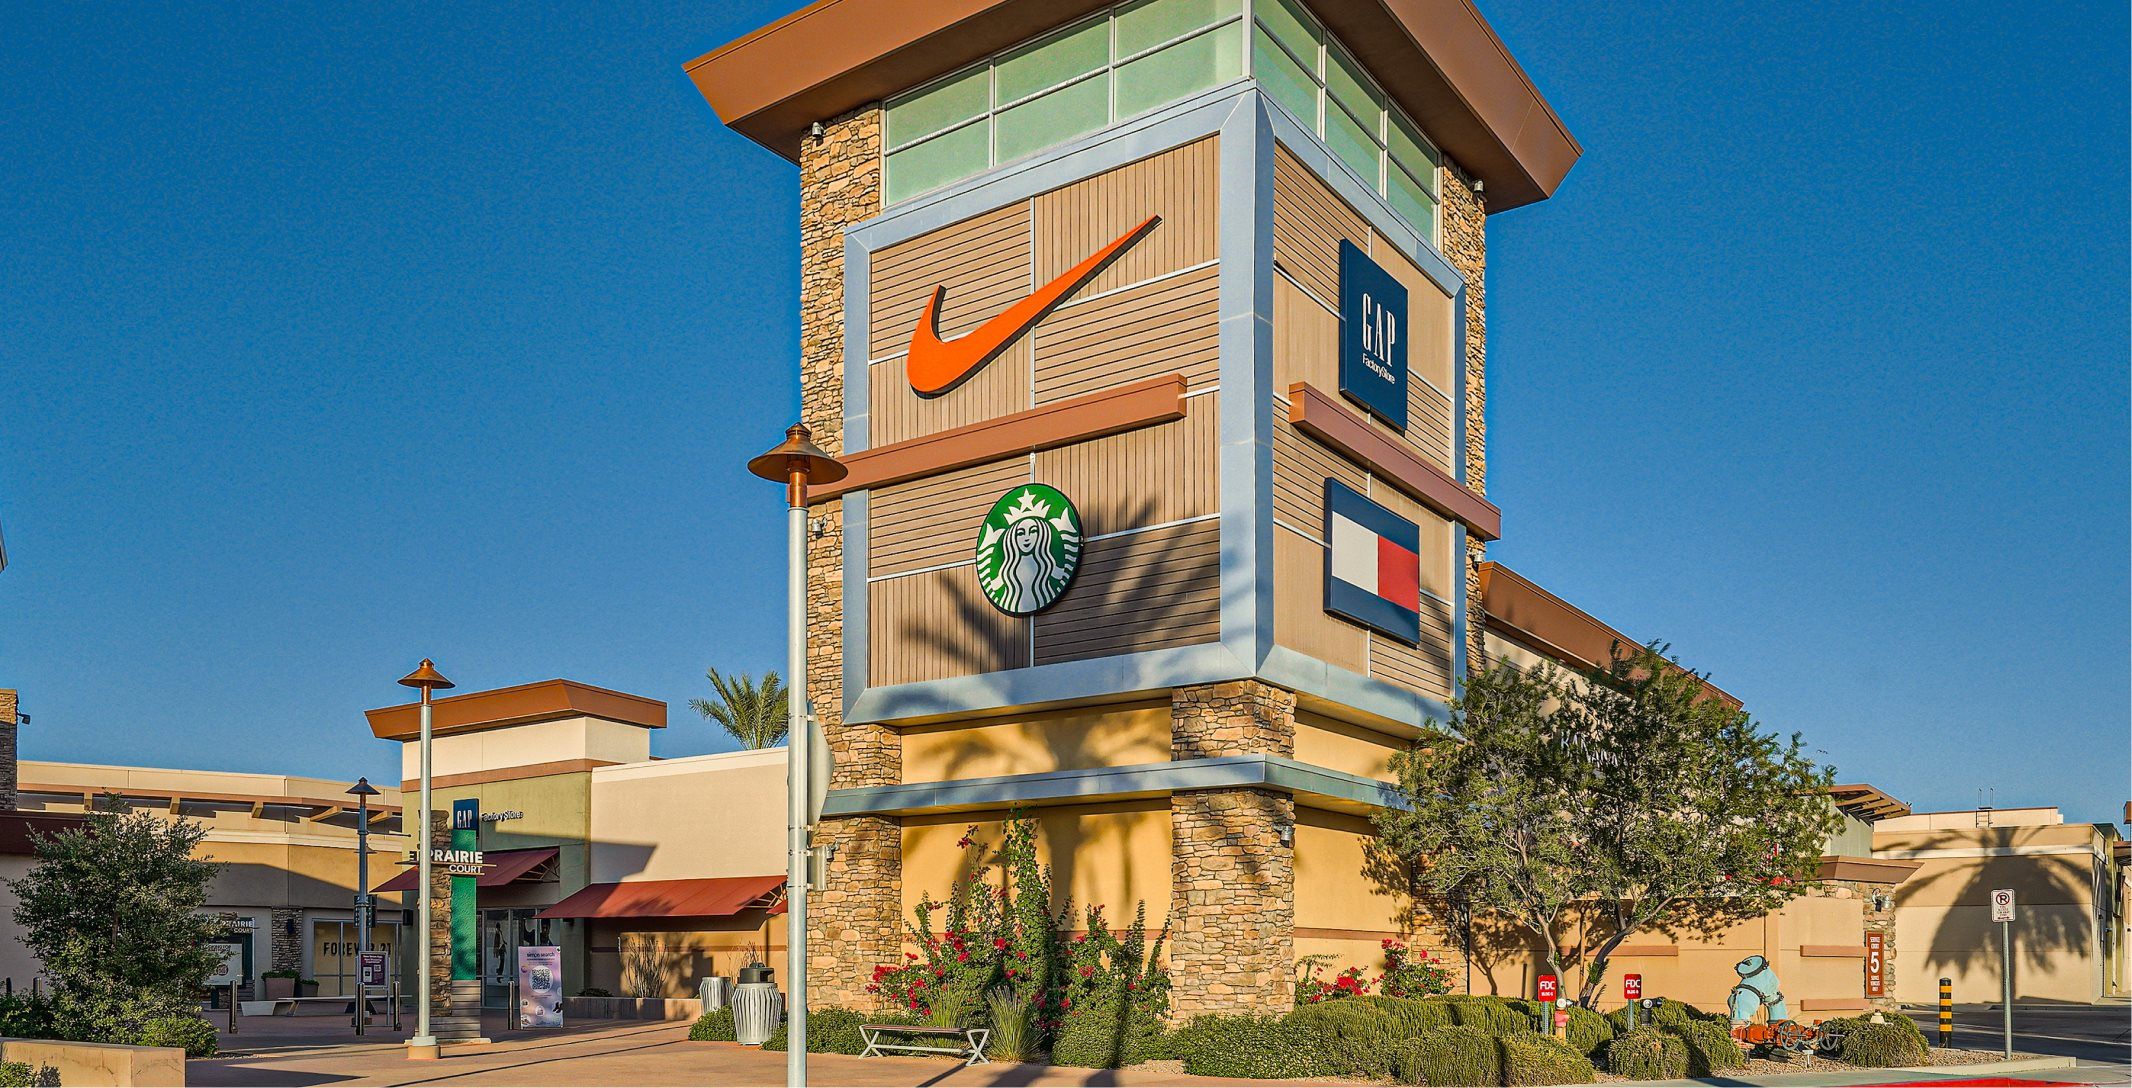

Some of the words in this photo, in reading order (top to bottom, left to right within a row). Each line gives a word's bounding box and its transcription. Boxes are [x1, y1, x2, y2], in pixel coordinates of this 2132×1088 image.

[1362, 293, 1396, 367] GAP
[456, 810, 473, 828] GAP
[449, 864, 482, 873] COURT
[323, 942, 375, 956] FOEV
[1870, 951, 1880, 973] 5
[1540, 981, 1555, 990] FDC
[1625, 979, 1640, 988] FDC
